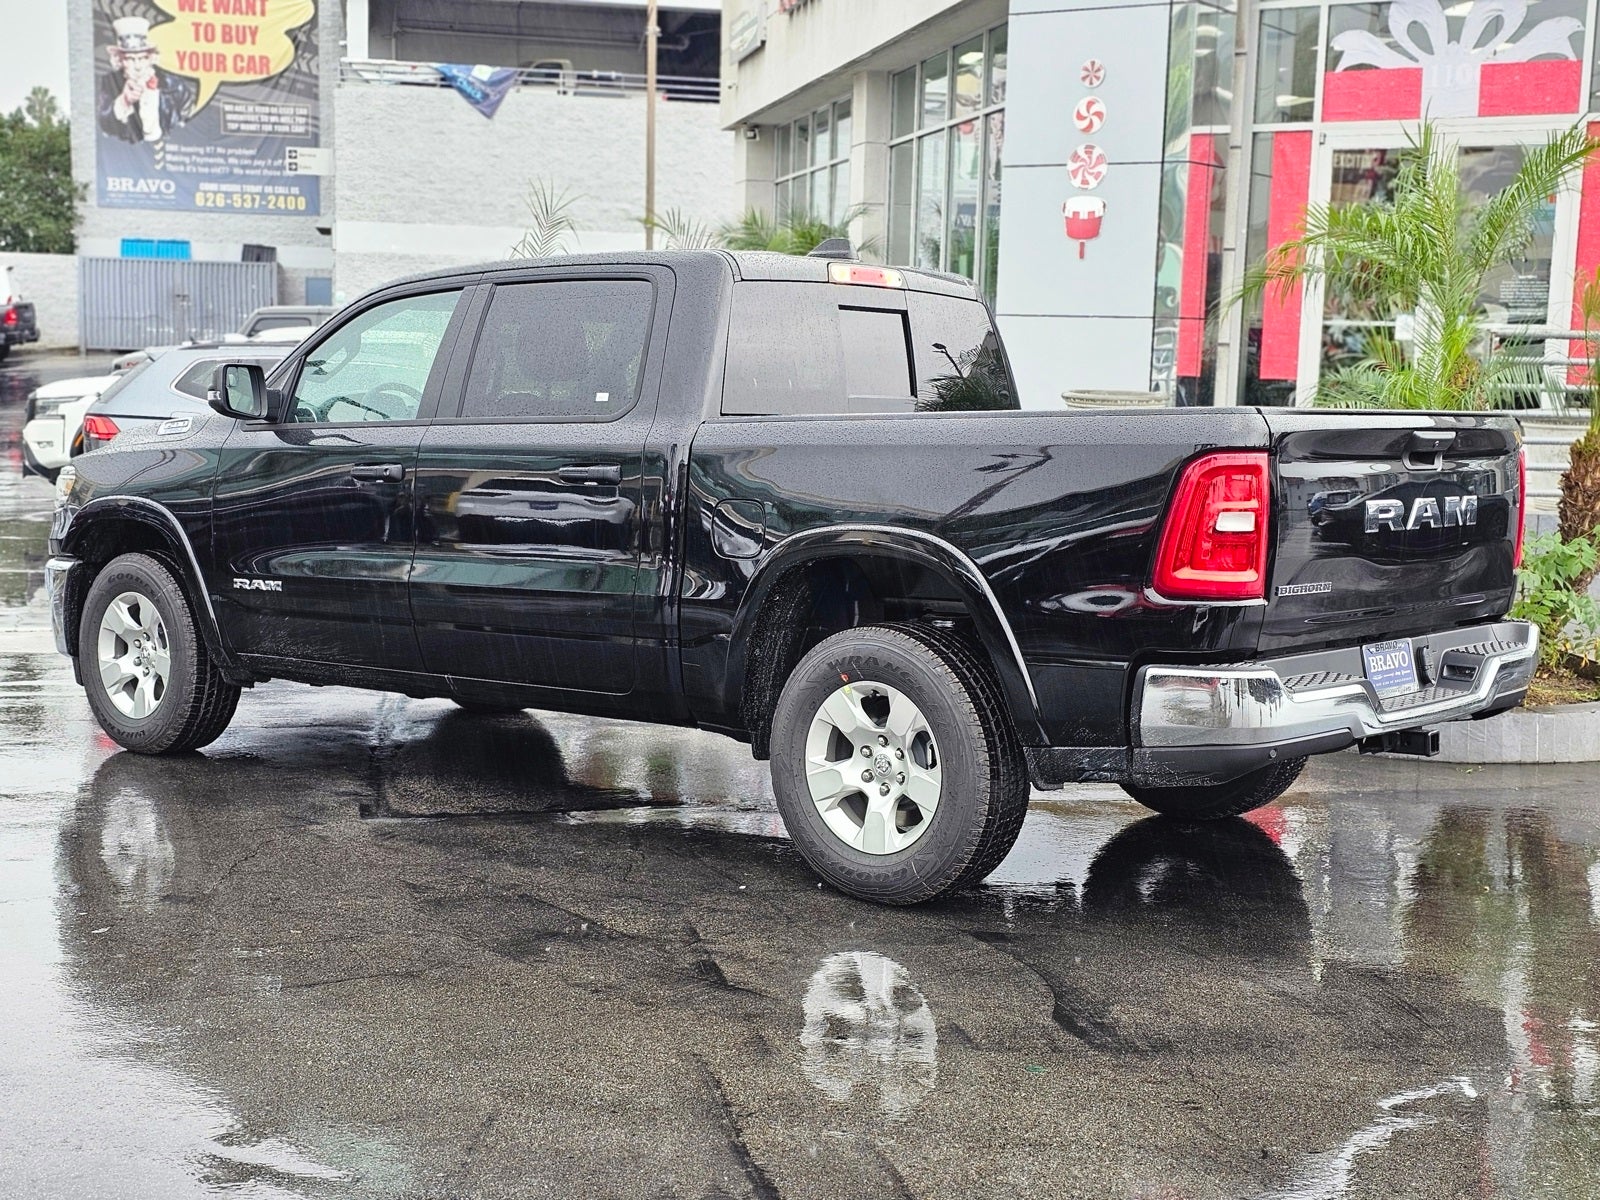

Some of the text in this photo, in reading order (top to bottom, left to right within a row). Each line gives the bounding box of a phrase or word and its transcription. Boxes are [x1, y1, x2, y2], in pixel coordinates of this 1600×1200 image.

[178, 0, 268, 17] WE WANT
[191, 22, 258, 45] TO BUY
[176, 50, 271, 76] YOUR CAR
[106, 177, 176, 194] BRAVO
[195, 191, 306, 210] 626-537-2400
[1364, 495, 1478, 533] RAM
[233, 578, 282, 591] RAM
[1278, 582, 1332, 597] BIGHORN
[1369, 651, 1409, 673] BRAVO
